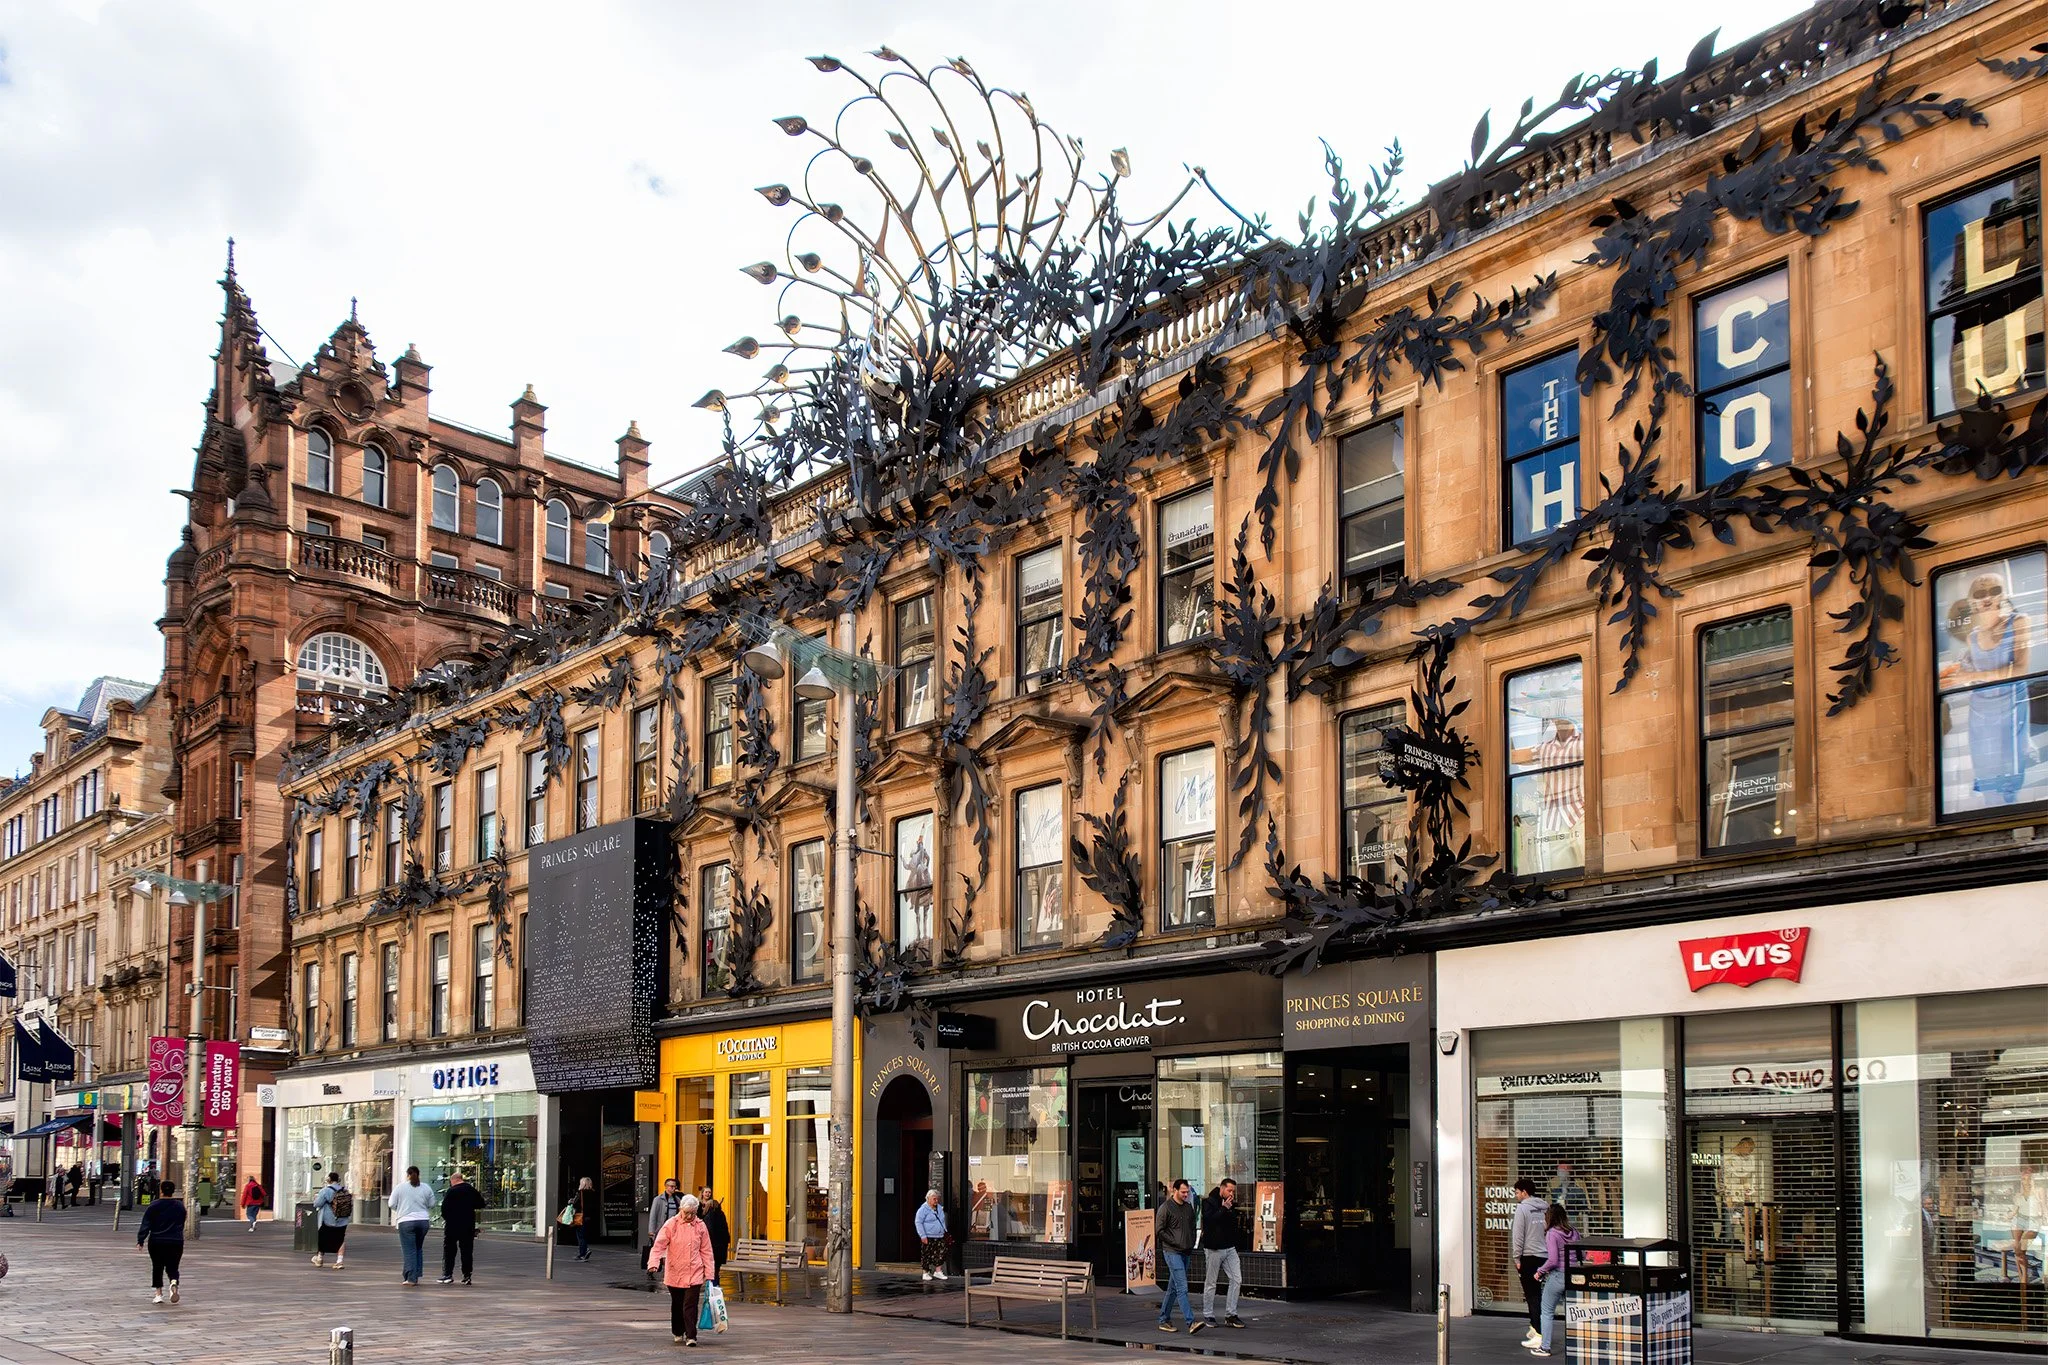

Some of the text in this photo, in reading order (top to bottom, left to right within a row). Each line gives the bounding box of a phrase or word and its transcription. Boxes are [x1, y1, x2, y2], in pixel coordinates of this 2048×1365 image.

[1404, 743, 1458, 769] PRINCES SQUARE
[1712, 782, 1793, 801] CONNECTION
[1728, 776, 1777, 789] FRENCH
[541, 834, 621, 869] PRINCES SQUARE
[1351, 847, 1408, 862] CONNECTION
[1361, 841, 1397, 853] FRENCH
[1076, 987, 1124, 1003] HOTEL
[1286, 986, 1423, 1013] PRINCES SQUARE
[1022, 998, 1185, 1041] Chocolat.
[1296, 1012, 1405, 1031] SHOPPING & DINING
[717, 1036, 777, 1055] L'OCCITANE
[1051, 1035, 1150, 1052] BRITISH COCOA GROWER
[433, 1064, 498, 1090] OFFICE
[870, 1055, 941, 1098] PRINCES SQUARE
[222, 1091, 231, 1111] 850
[1485, 1187, 1515, 1198] ICONS
[1485, 1218, 1513, 1230] DAILY
[1569, 1298, 1640, 1321] Bin your litter!
